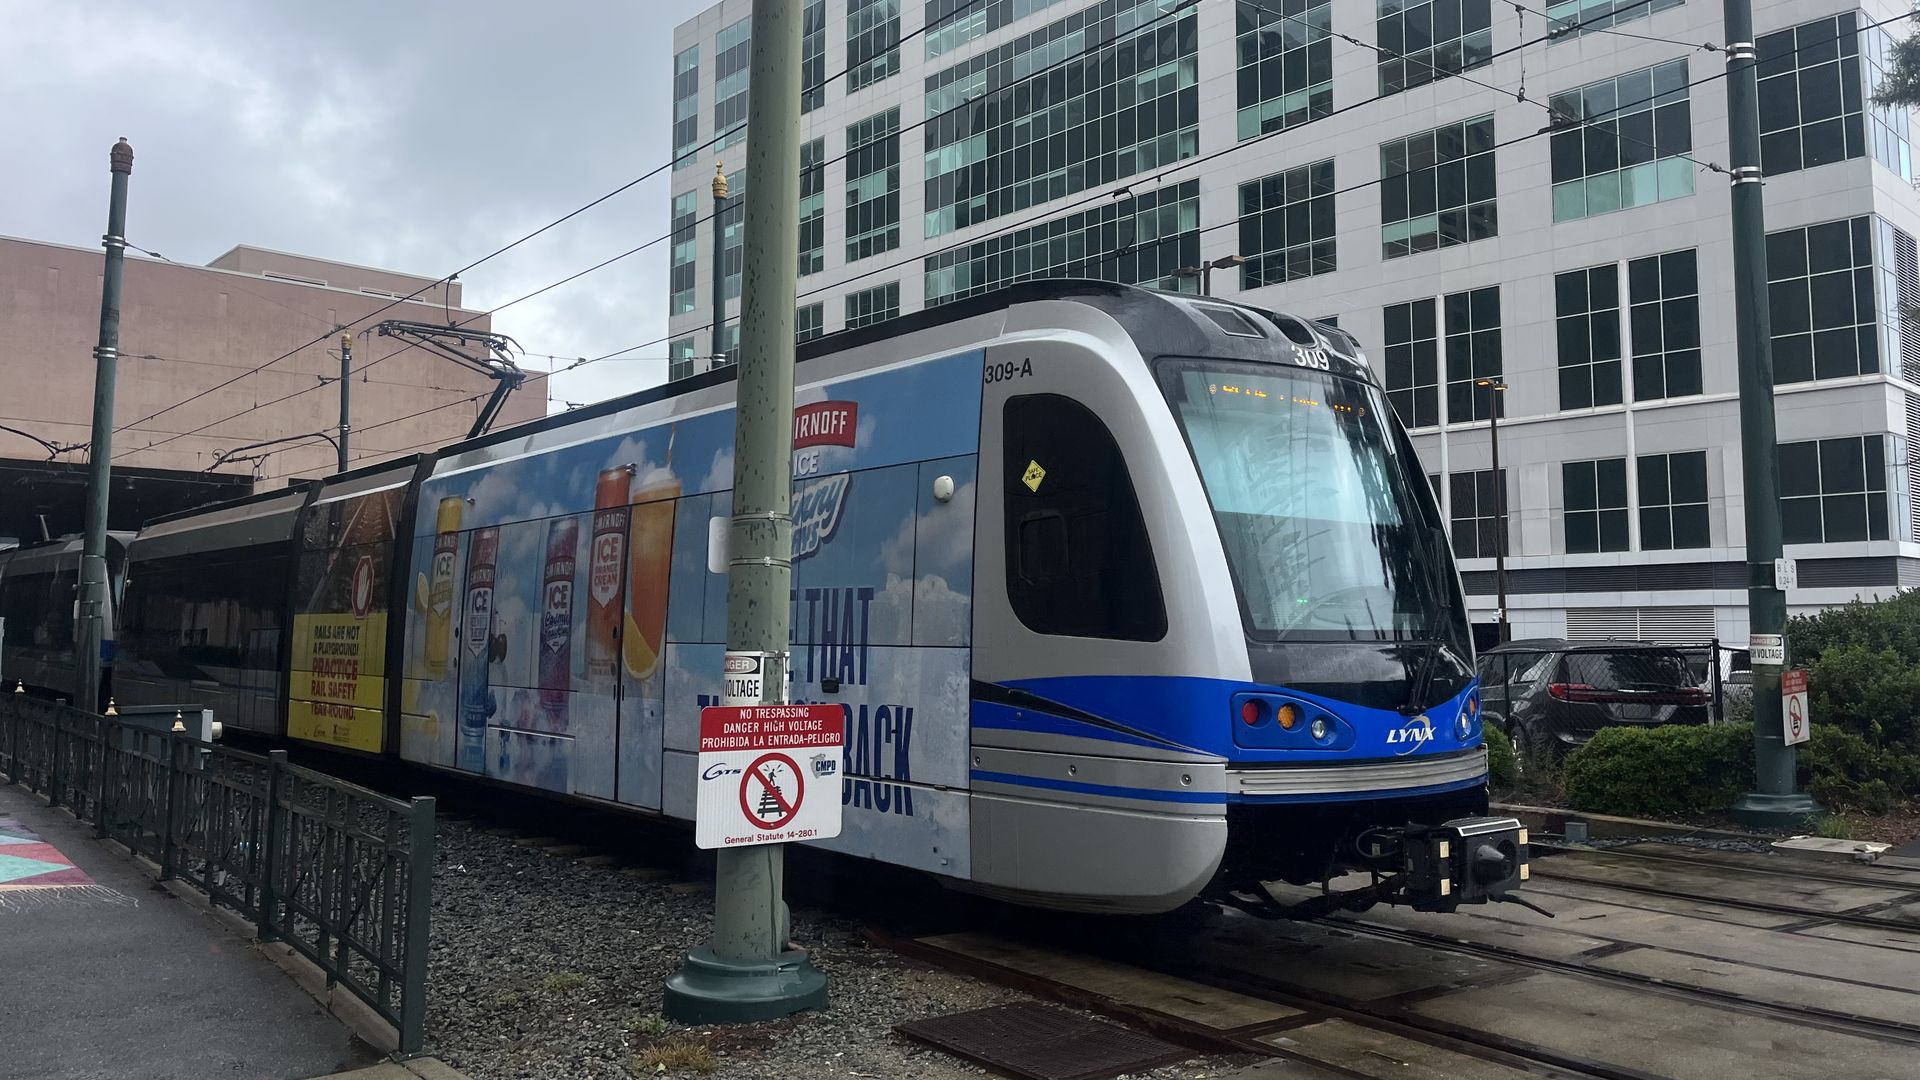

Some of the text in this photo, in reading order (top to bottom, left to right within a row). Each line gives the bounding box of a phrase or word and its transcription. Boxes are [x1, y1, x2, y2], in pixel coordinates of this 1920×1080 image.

[1295, 347, 1329, 371] 309
[985, 357, 1033, 384] 309-A
[794, 411, 848, 440] IRNOFF
[793, 451, 819, 477] ICE
[597, 537, 619, 563] ICE
[436, 556, 452, 576] ICE
[594, 574, 618, 586] CREAM
[472, 590, 489, 613] ICE
[549, 585, 568, 609] ICE
[314, 625, 331, 639] RAILS
[346, 625, 360, 640] NOT
[806, 587, 874, 685] THAT
[1757, 648, 1783, 659] VOLTAGE
[312, 657, 358, 680] PRACTICE
[311, 680, 357, 700] RAIL SAFETY
[725, 679, 760, 698] OLTAGE
[740, 707, 809, 720] NO TRESPASSING
[723, 720, 823, 734] DANGER HIGH VOLTAGE
[1386, 726, 1437, 744] LYNX
[702, 733, 841, 749] PROHIBIDA LA ENTRADA-PELIGRO
[815, 760, 836, 771] CMPD
[724, 829, 818, 845] General Statute 14-280.1
